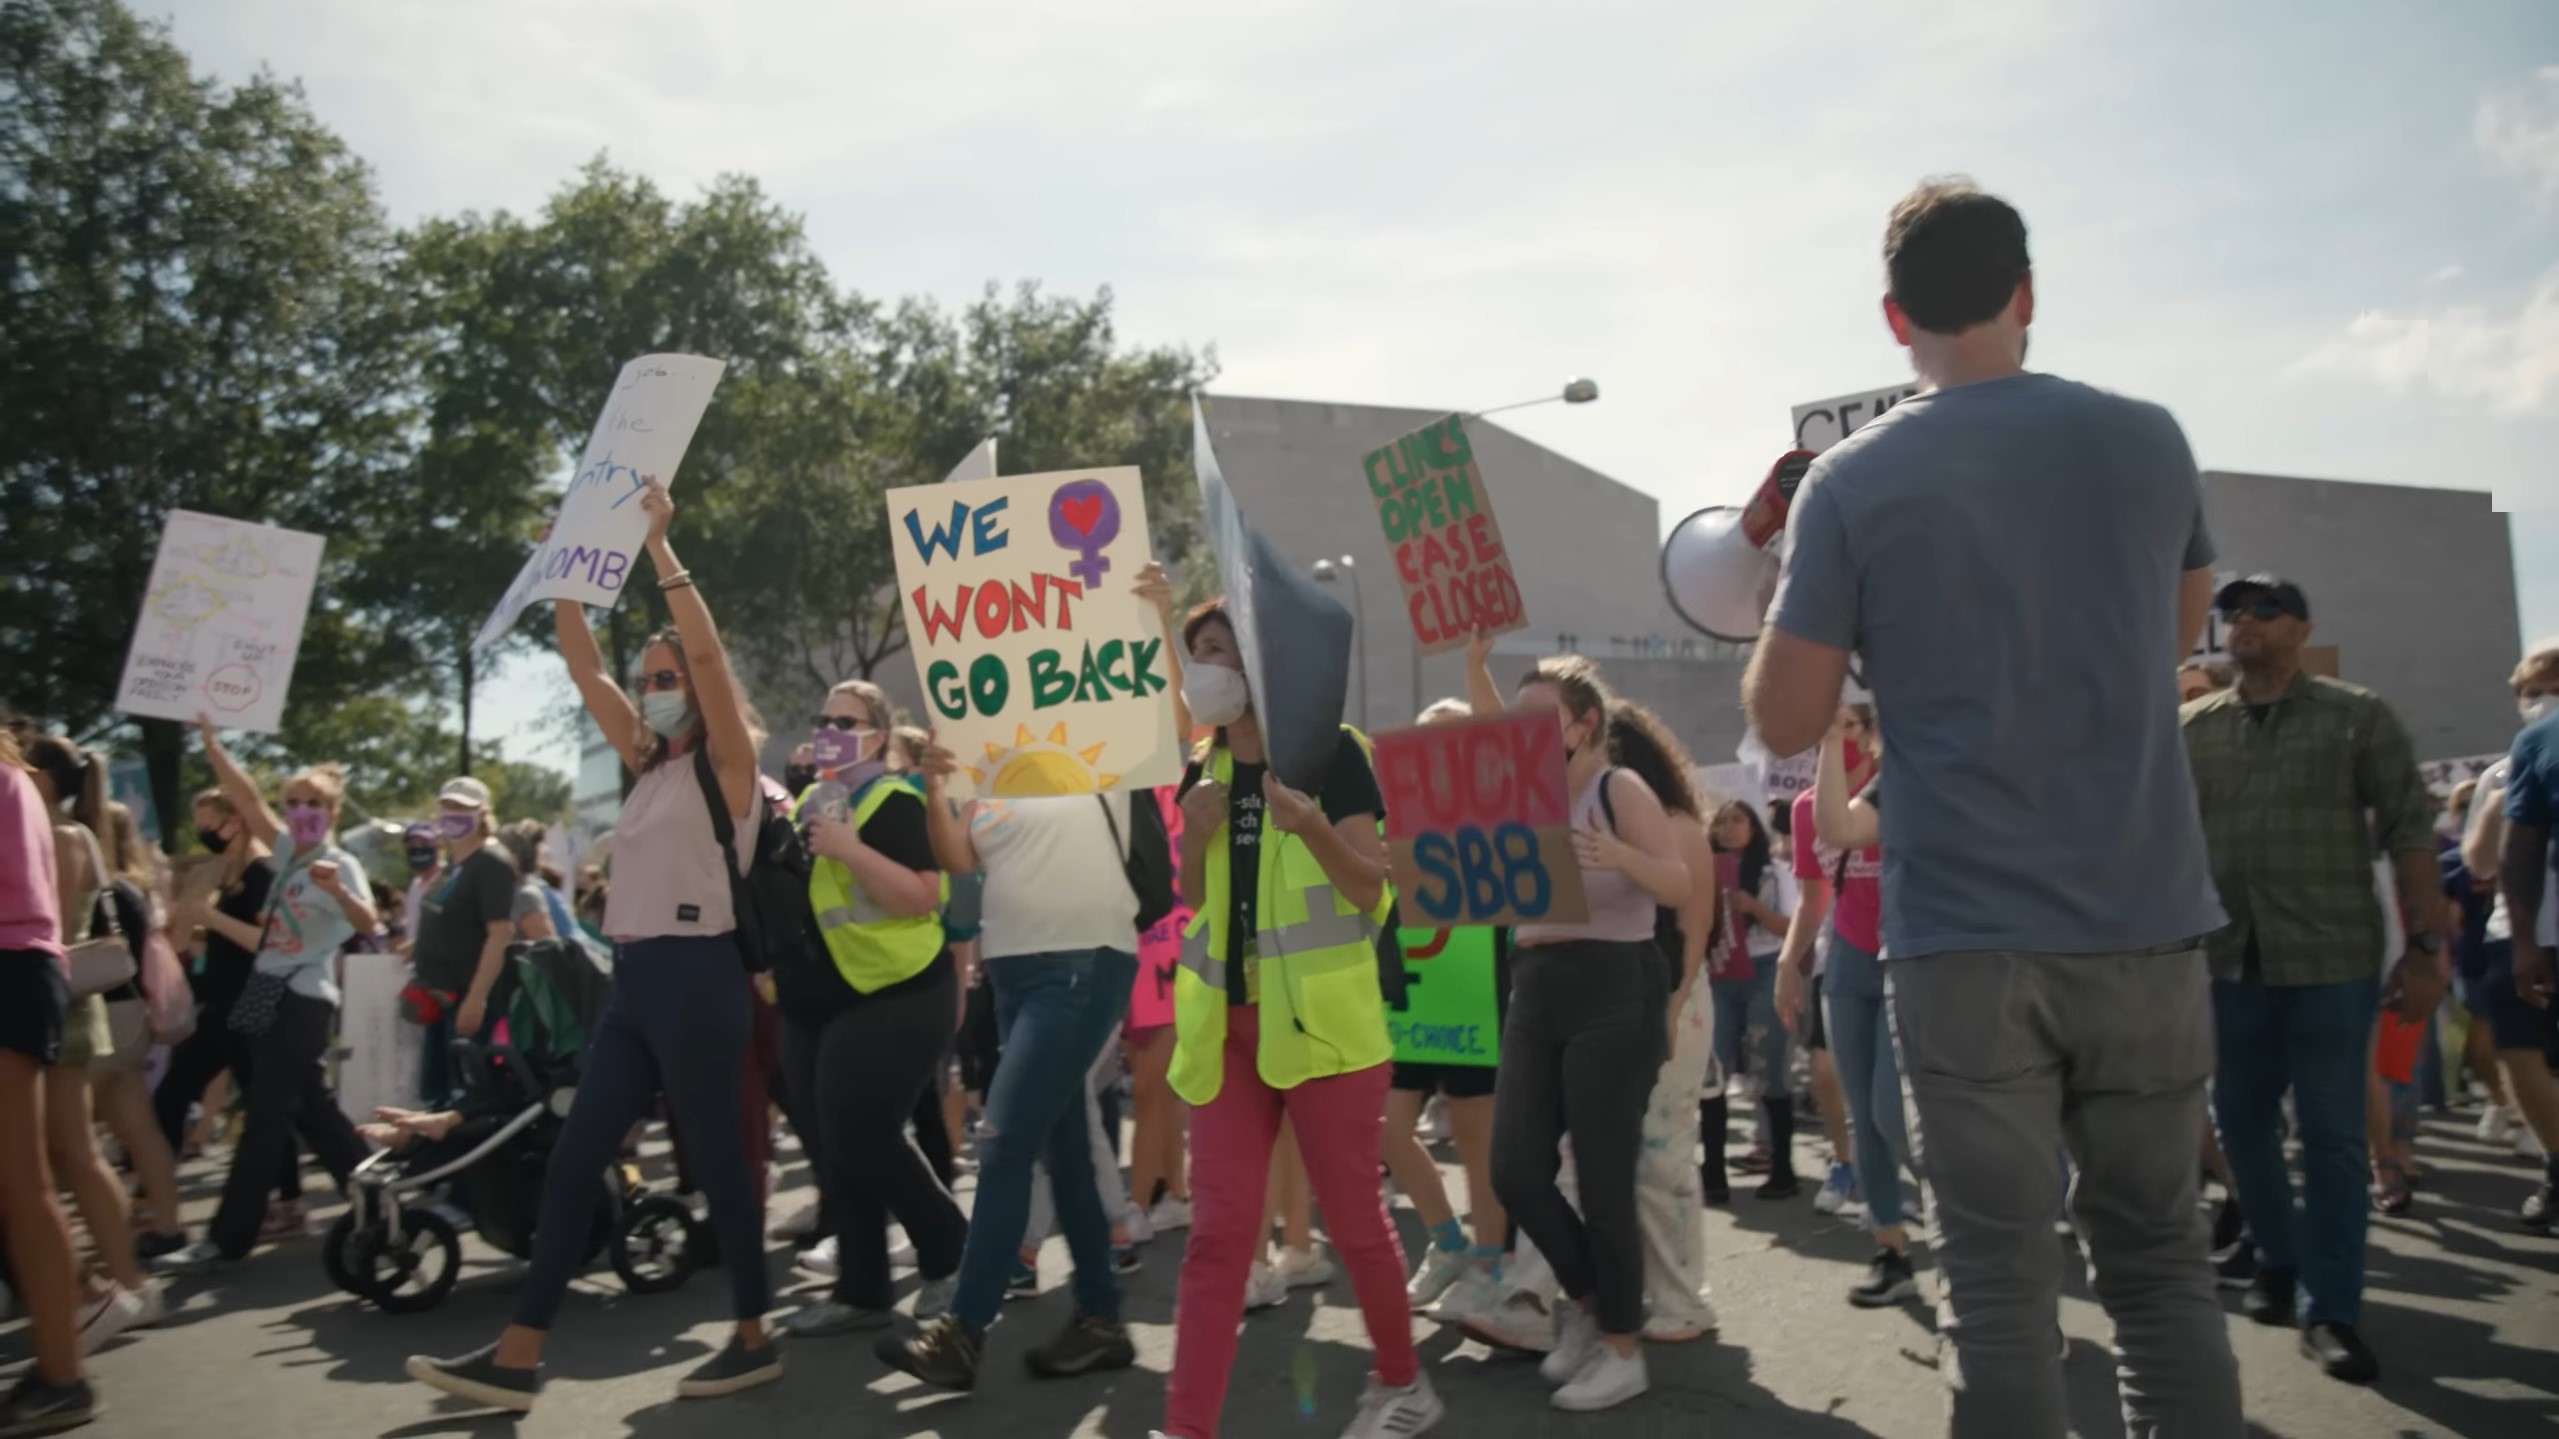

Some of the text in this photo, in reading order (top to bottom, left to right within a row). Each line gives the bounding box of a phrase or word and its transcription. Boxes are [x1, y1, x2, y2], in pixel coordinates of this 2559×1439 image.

[903, 495, 1009, 567] WE
[1380, 468, 1477, 543] OPEN
[1396, 513, 1501, 584] CASE
[911, 571, 1083, 647] WONT
[1410, 563, 1521, 645] CLOSED
[212, 680, 252, 696] STOP
[927, 636, 1168, 720] GO BACK
[1381, 718, 1562, 838] FUCK
[1413, 822, 1552, 922] SB8
